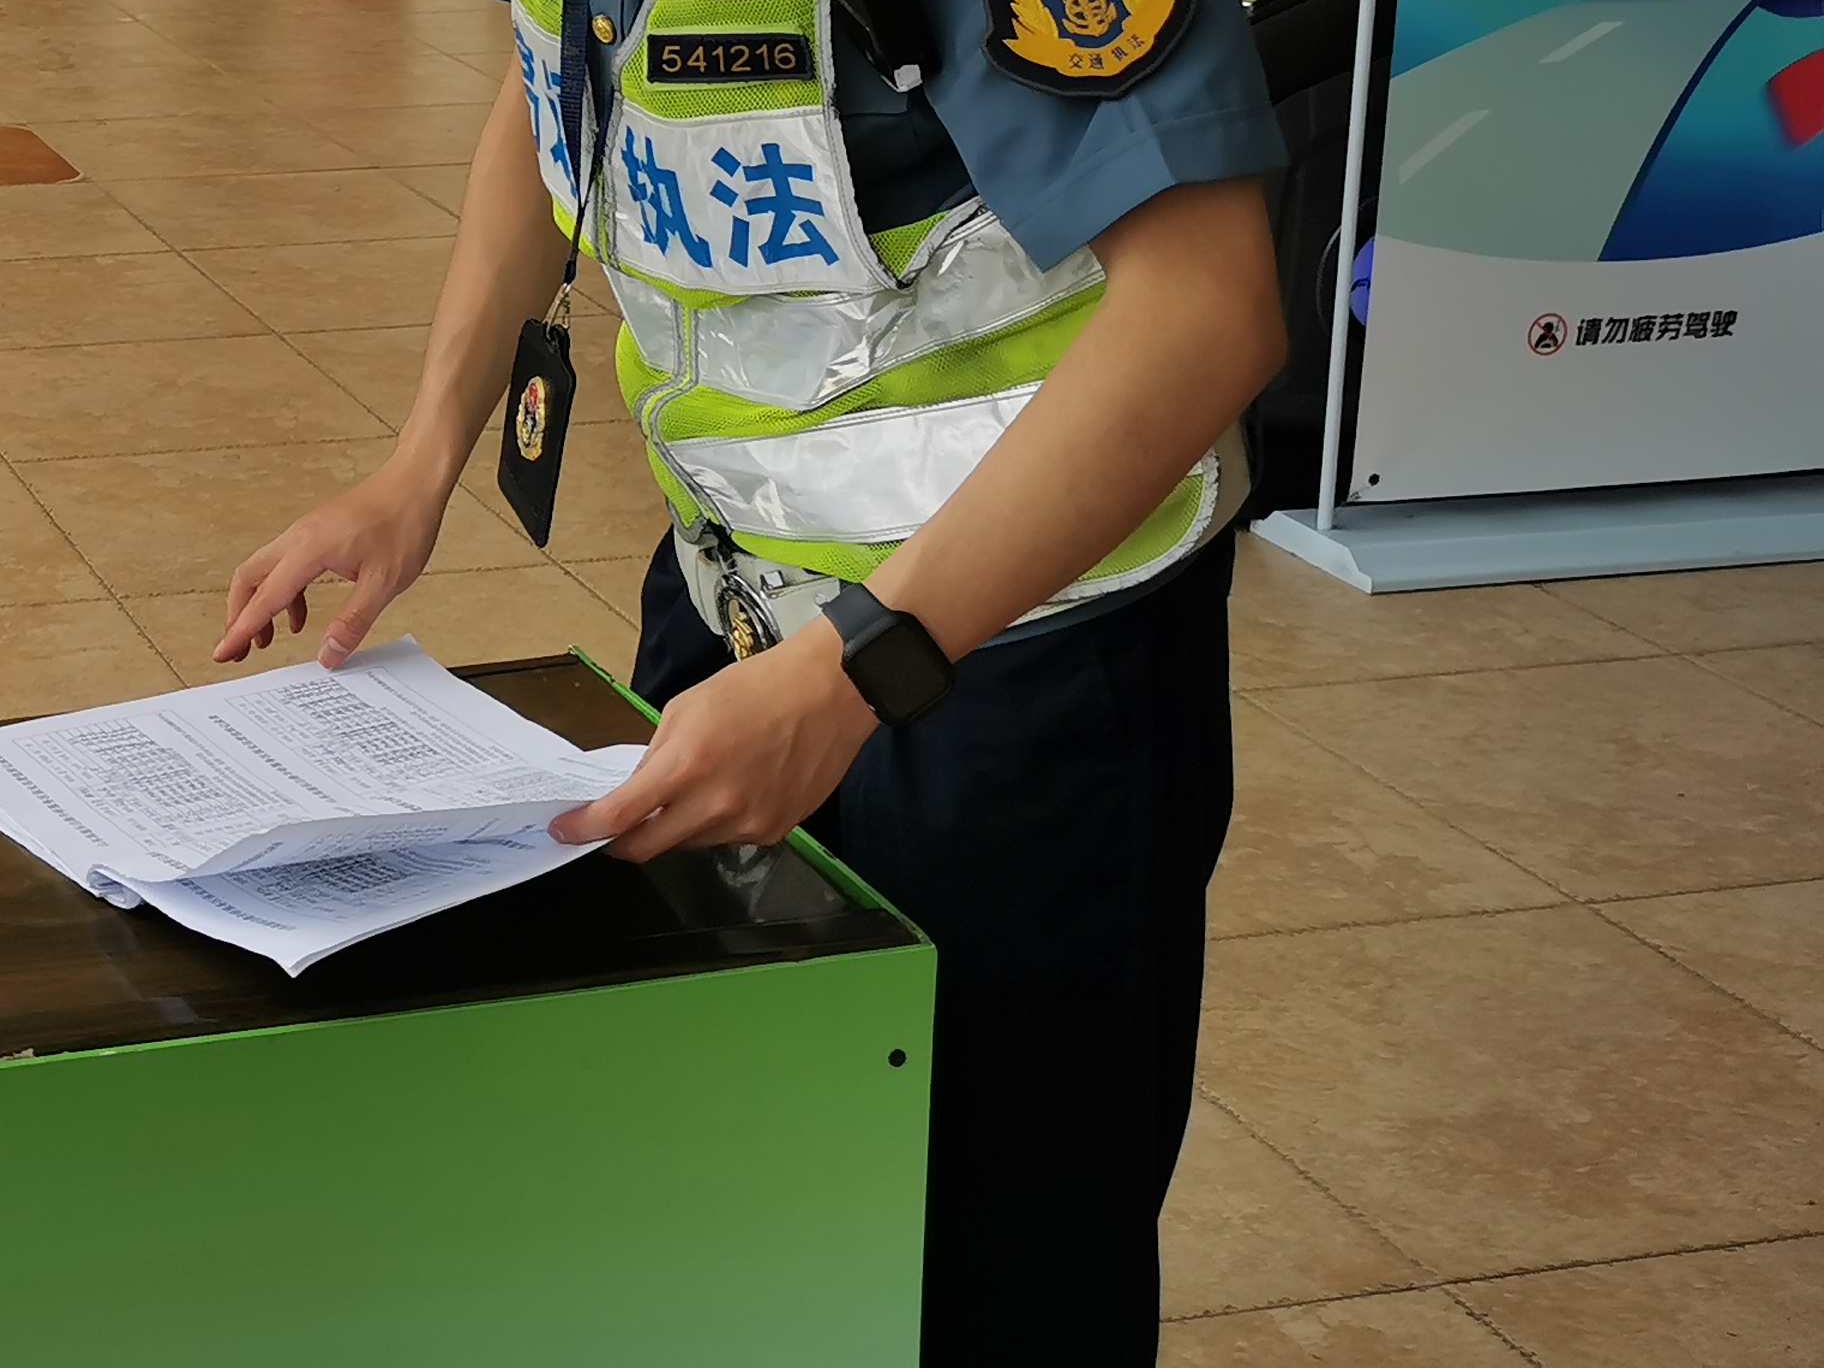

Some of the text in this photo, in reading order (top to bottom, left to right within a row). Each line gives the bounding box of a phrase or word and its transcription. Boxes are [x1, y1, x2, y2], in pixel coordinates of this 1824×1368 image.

[660, 42, 798, 74] 541216
[1067, 33, 1146, 70] 交通执法
[1574, 310, 1739, 347] 请勿疲劳驾驶
